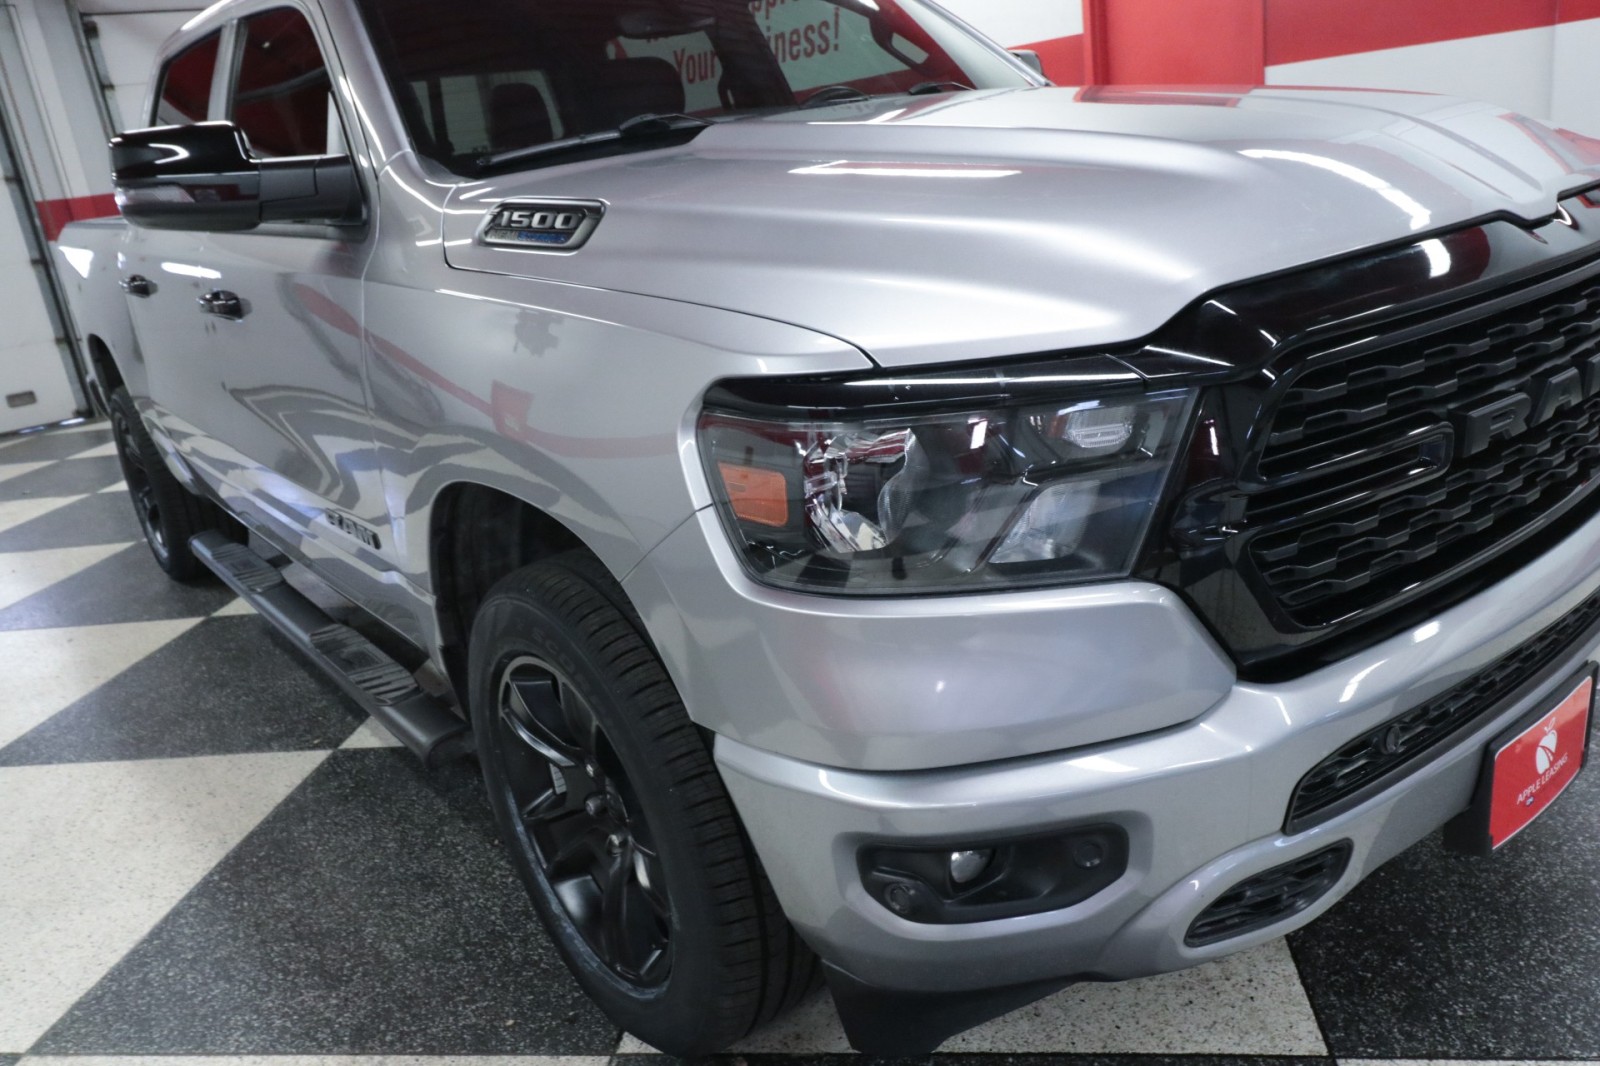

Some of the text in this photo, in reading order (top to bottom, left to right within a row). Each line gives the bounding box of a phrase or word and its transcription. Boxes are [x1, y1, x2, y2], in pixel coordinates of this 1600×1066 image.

[672, 47, 718, 85] Your
[766, 6, 840, 64] iness!
[500, 210, 581, 230] 1500
[1516, 751, 1568, 805] APPLE LEASING
